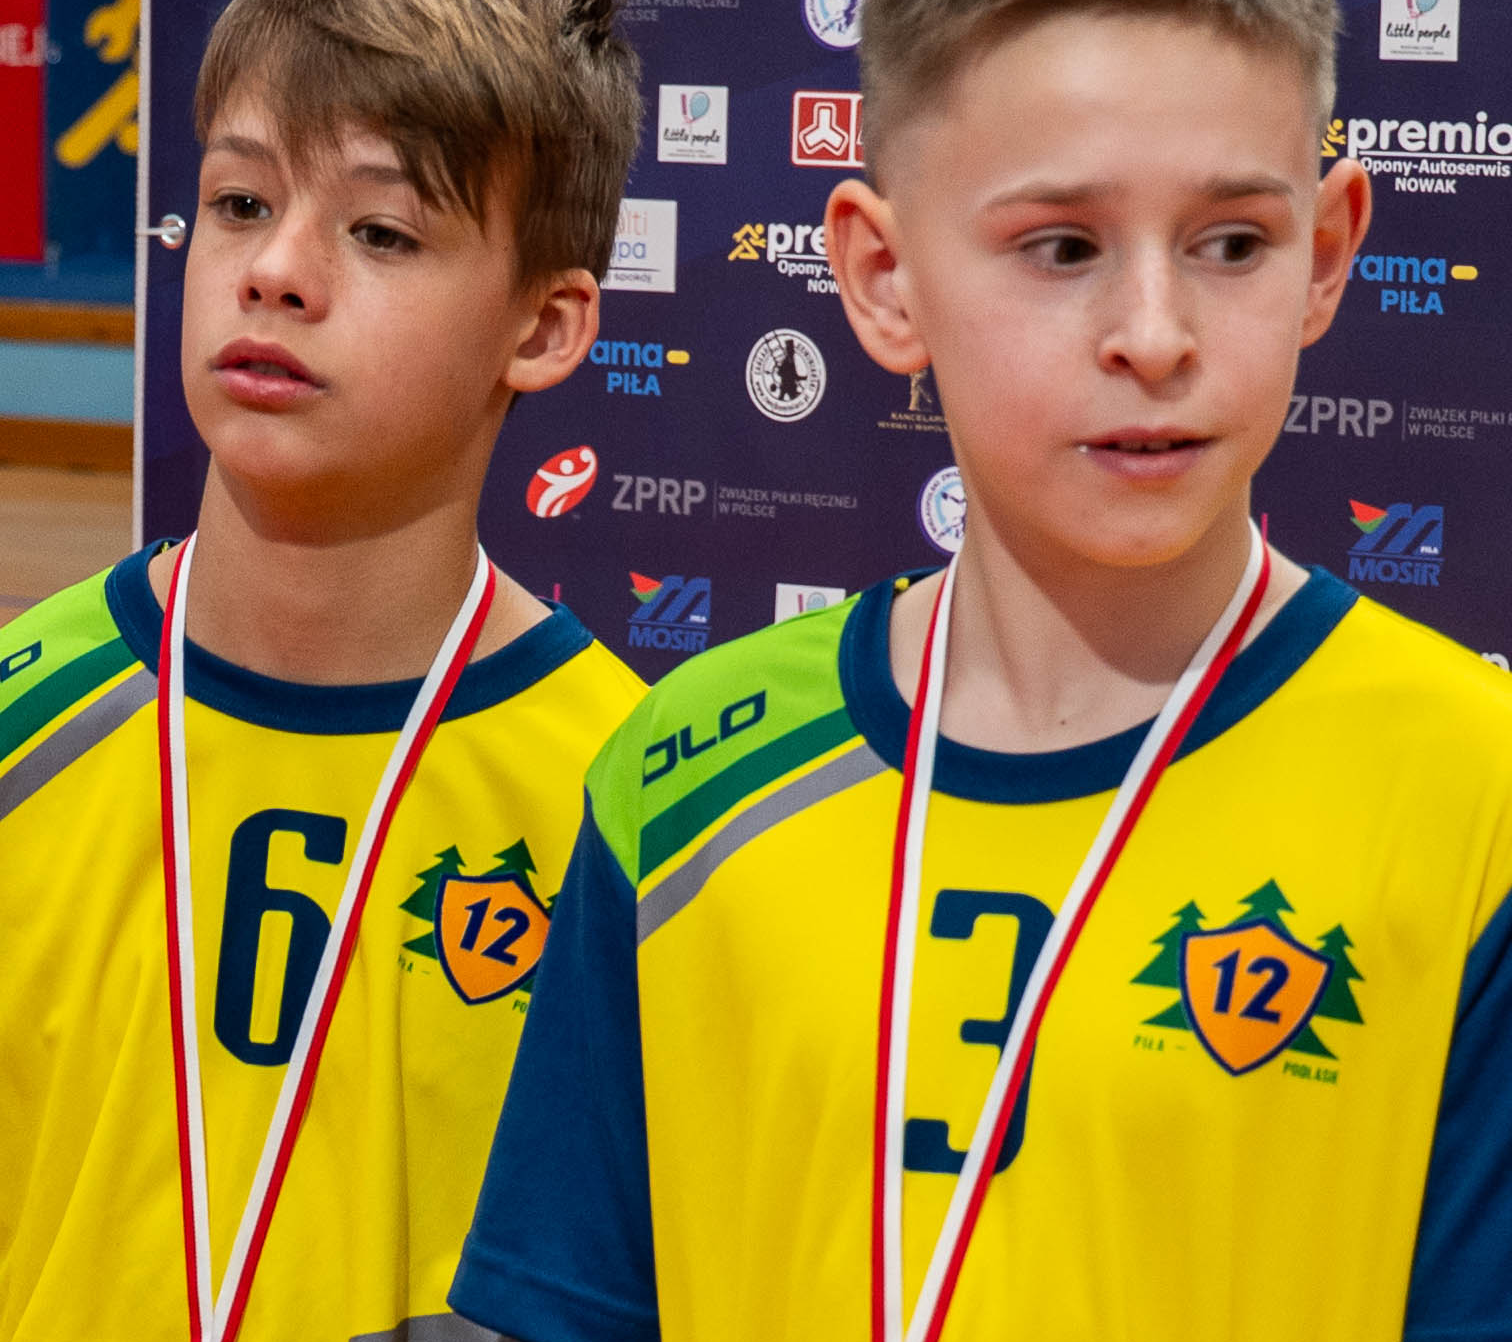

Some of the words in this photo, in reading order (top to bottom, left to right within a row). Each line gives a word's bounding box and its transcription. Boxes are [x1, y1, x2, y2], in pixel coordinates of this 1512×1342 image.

[1361, 156, 1511, 177] Opony-Autoserwis
[1395, 177, 1456, 193] NOWAK
[767, 223, 827, 263] pre
[807, 279, 840, 293] NOW
[1381, 289, 1444, 315] PIŁA
[607, 372, 661, 396] PIŁA
[1283, 395, 1394, 438] ZPRP
[1408, 423, 1421, 436] W
[1423, 424, 1475, 440] POLSCE
[612, 474, 707, 515] ZPRP
[643, 690, 766, 787] OLO
[213, 808, 347, 1067] 6
[458, 897, 531, 966] 12
[1211, 948, 1290, 1024] 12
[903, 889, 1056, 1175] 3
